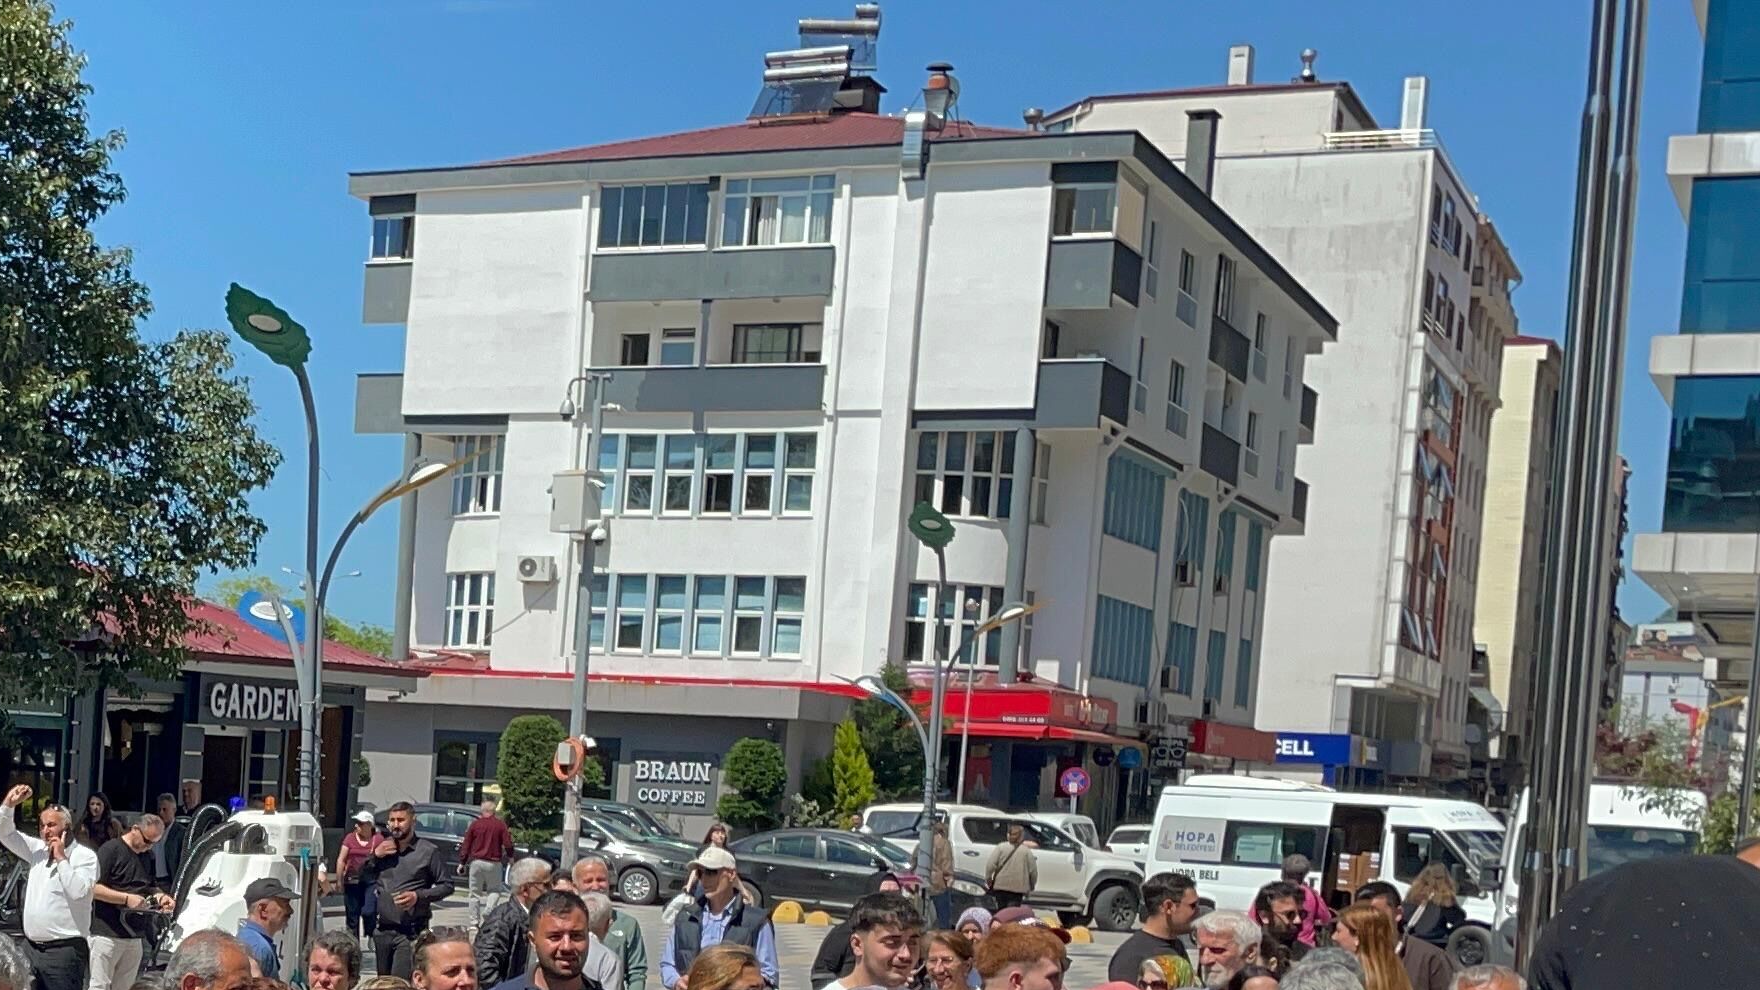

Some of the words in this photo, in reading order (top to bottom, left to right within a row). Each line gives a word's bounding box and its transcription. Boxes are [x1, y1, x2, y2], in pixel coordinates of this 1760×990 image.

[210, 682, 300, 721] GARDEN
[635, 760, 712, 782] BRAUN
[638, 788, 706, 805] COFFEE
[1175, 831, 1216, 843] HOPA
